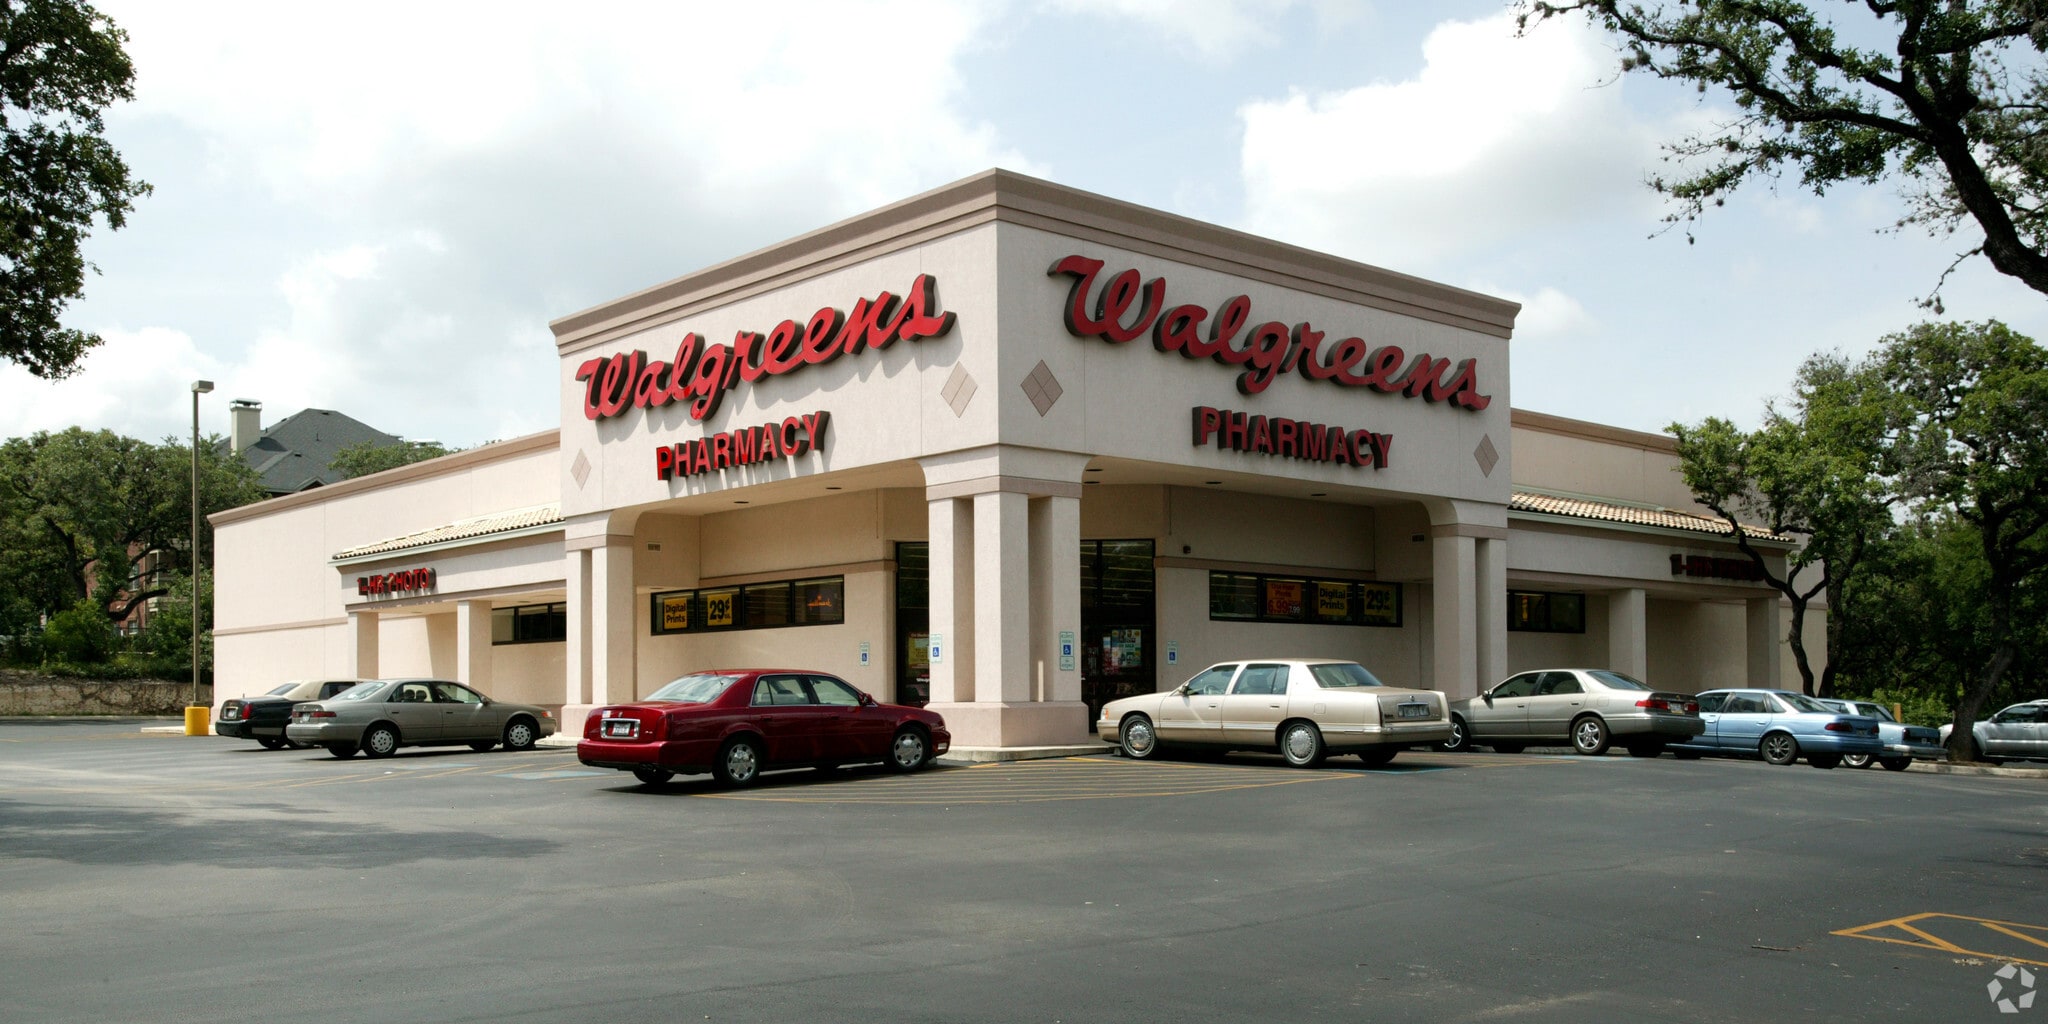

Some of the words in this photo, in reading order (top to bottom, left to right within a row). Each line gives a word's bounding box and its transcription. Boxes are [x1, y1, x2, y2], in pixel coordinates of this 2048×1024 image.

[575, 273, 957, 420] Walgreens
[1047, 255, 1492, 411] Walgreens
[656, 411, 830, 480] PHARMACY
[1192, 406, 1394, 469] PHARMACY
[357, 574, 385, 595] 1-HR
[386, 567, 436, 593] PHOTO
[1320, 588, 1346, 600] Digital
[665, 603, 686, 614] Digital
[666, 614, 686, 623] Prints
[1320, 600, 1344, 610] Prints
